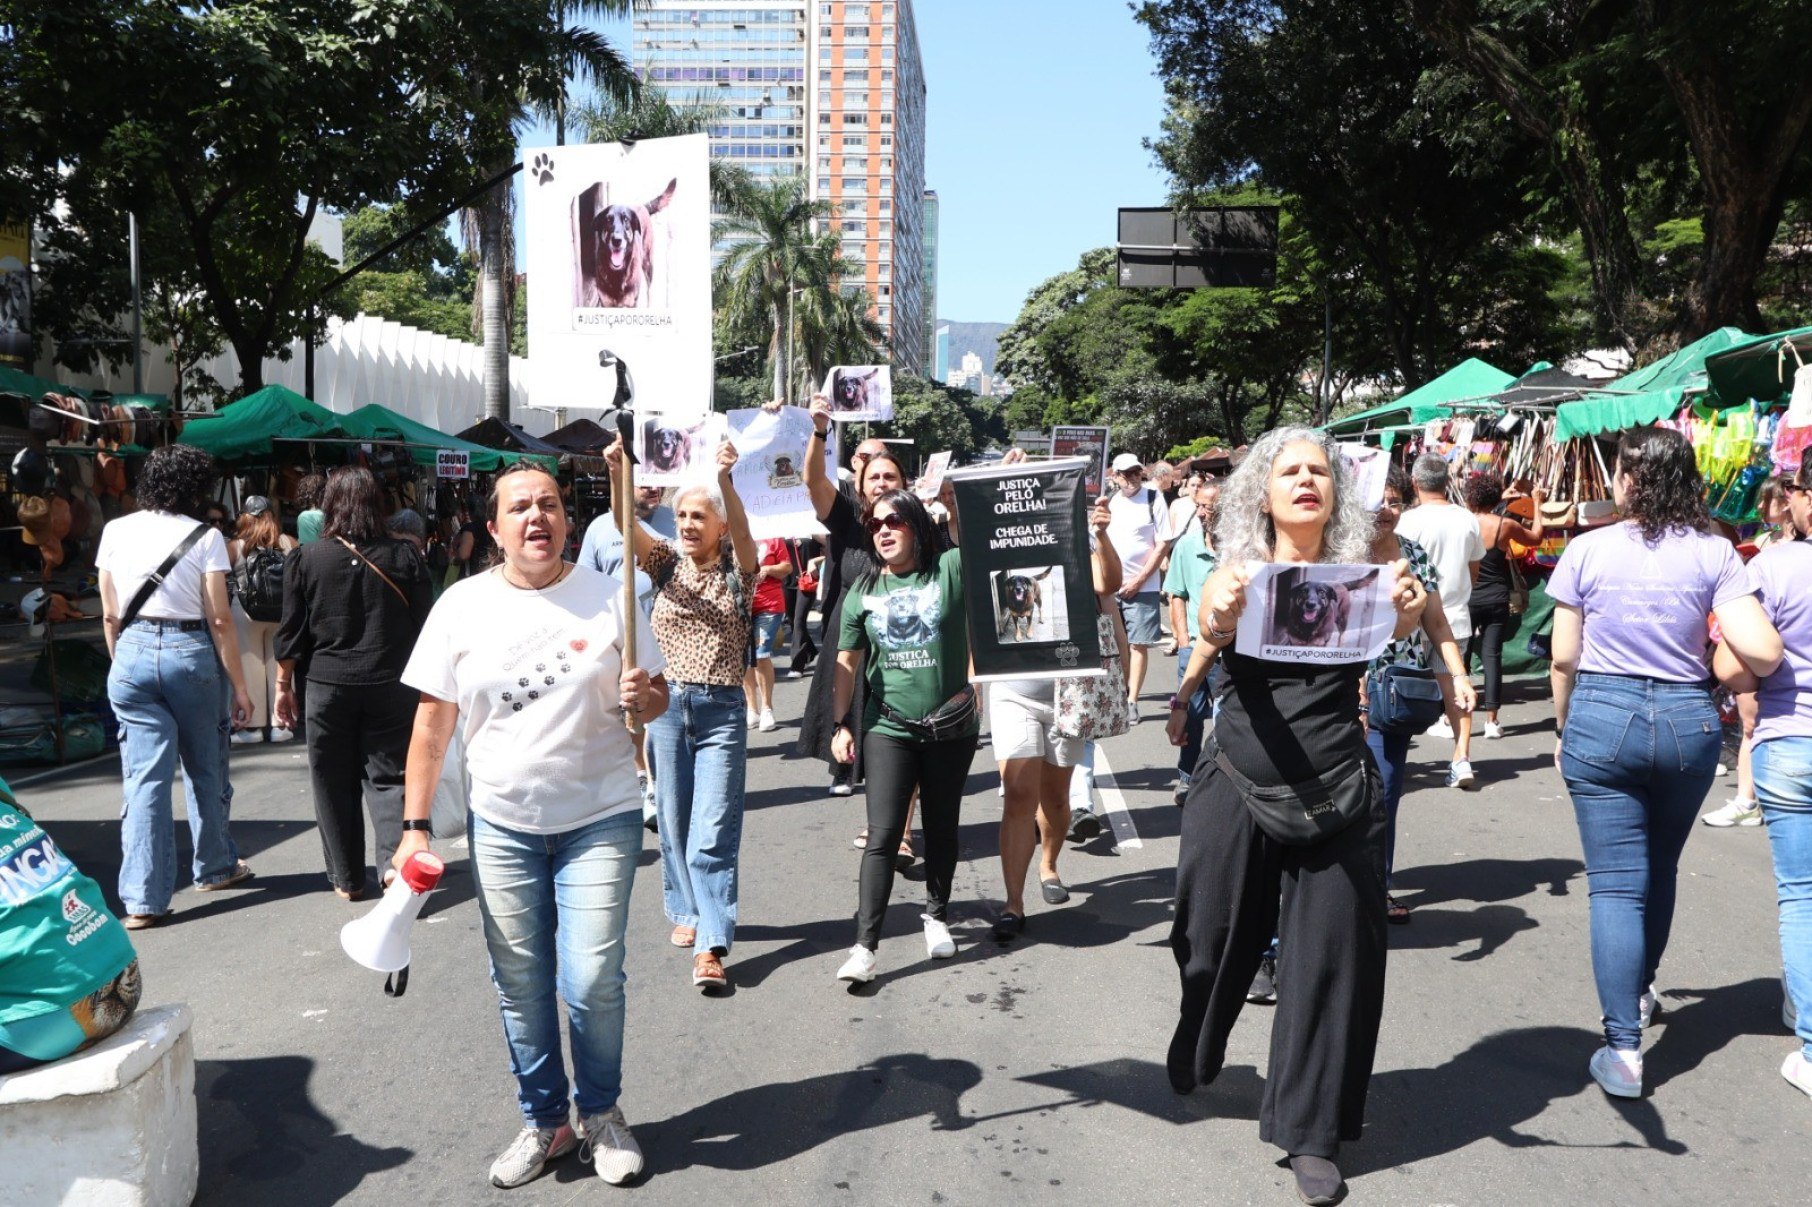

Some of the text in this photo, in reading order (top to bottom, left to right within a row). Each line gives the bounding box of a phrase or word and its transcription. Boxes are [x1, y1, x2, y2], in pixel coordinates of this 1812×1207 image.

[438, 453, 468, 465] COURO
[996, 478, 1041, 491] JUSTIÇA
[1005, 489, 1034, 501] PELO
[994, 498, 1047, 514] ORELHA!
[995, 523, 1048, 538] CHEGA DE
[1265, 648, 1361, 660] #JUSTIÇAPORORELHA
[900, 658, 938, 669] ORELHA
